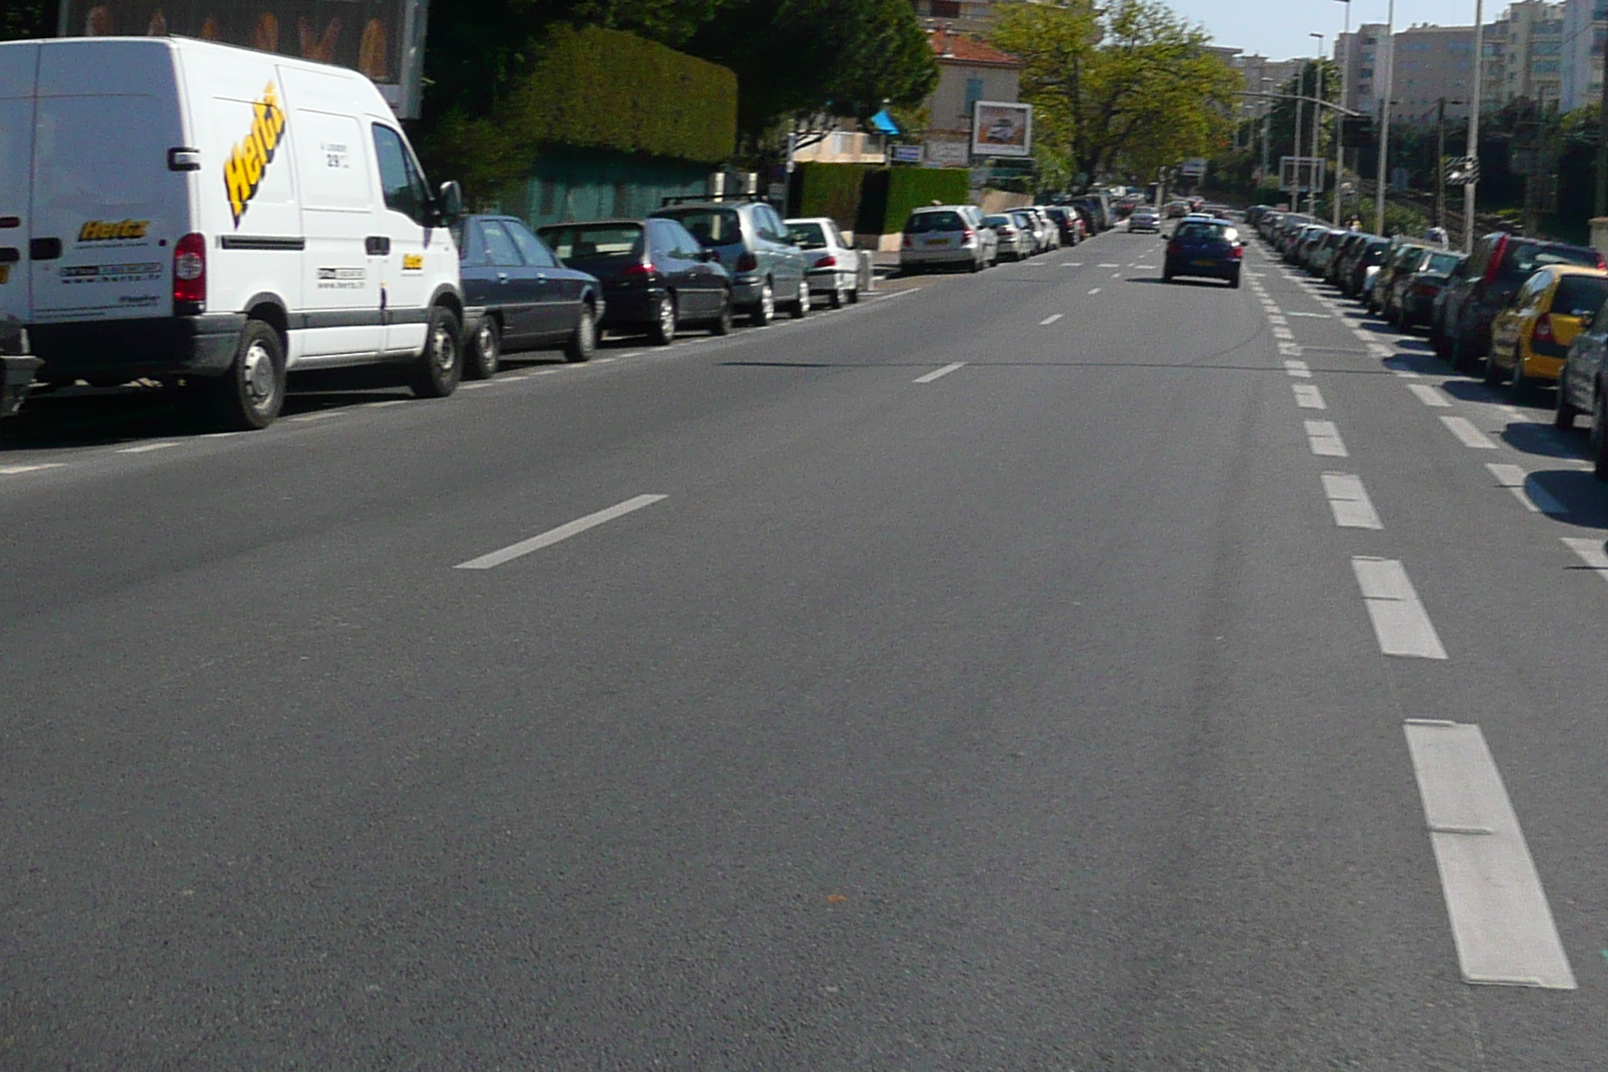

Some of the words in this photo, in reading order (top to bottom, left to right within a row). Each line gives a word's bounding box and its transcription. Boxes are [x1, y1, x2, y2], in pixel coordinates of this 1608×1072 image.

[223, 80, 286, 228] Hertz
[77, 218, 149, 242] Hertz
[61, 274, 162, 284] www.hertz.fr
